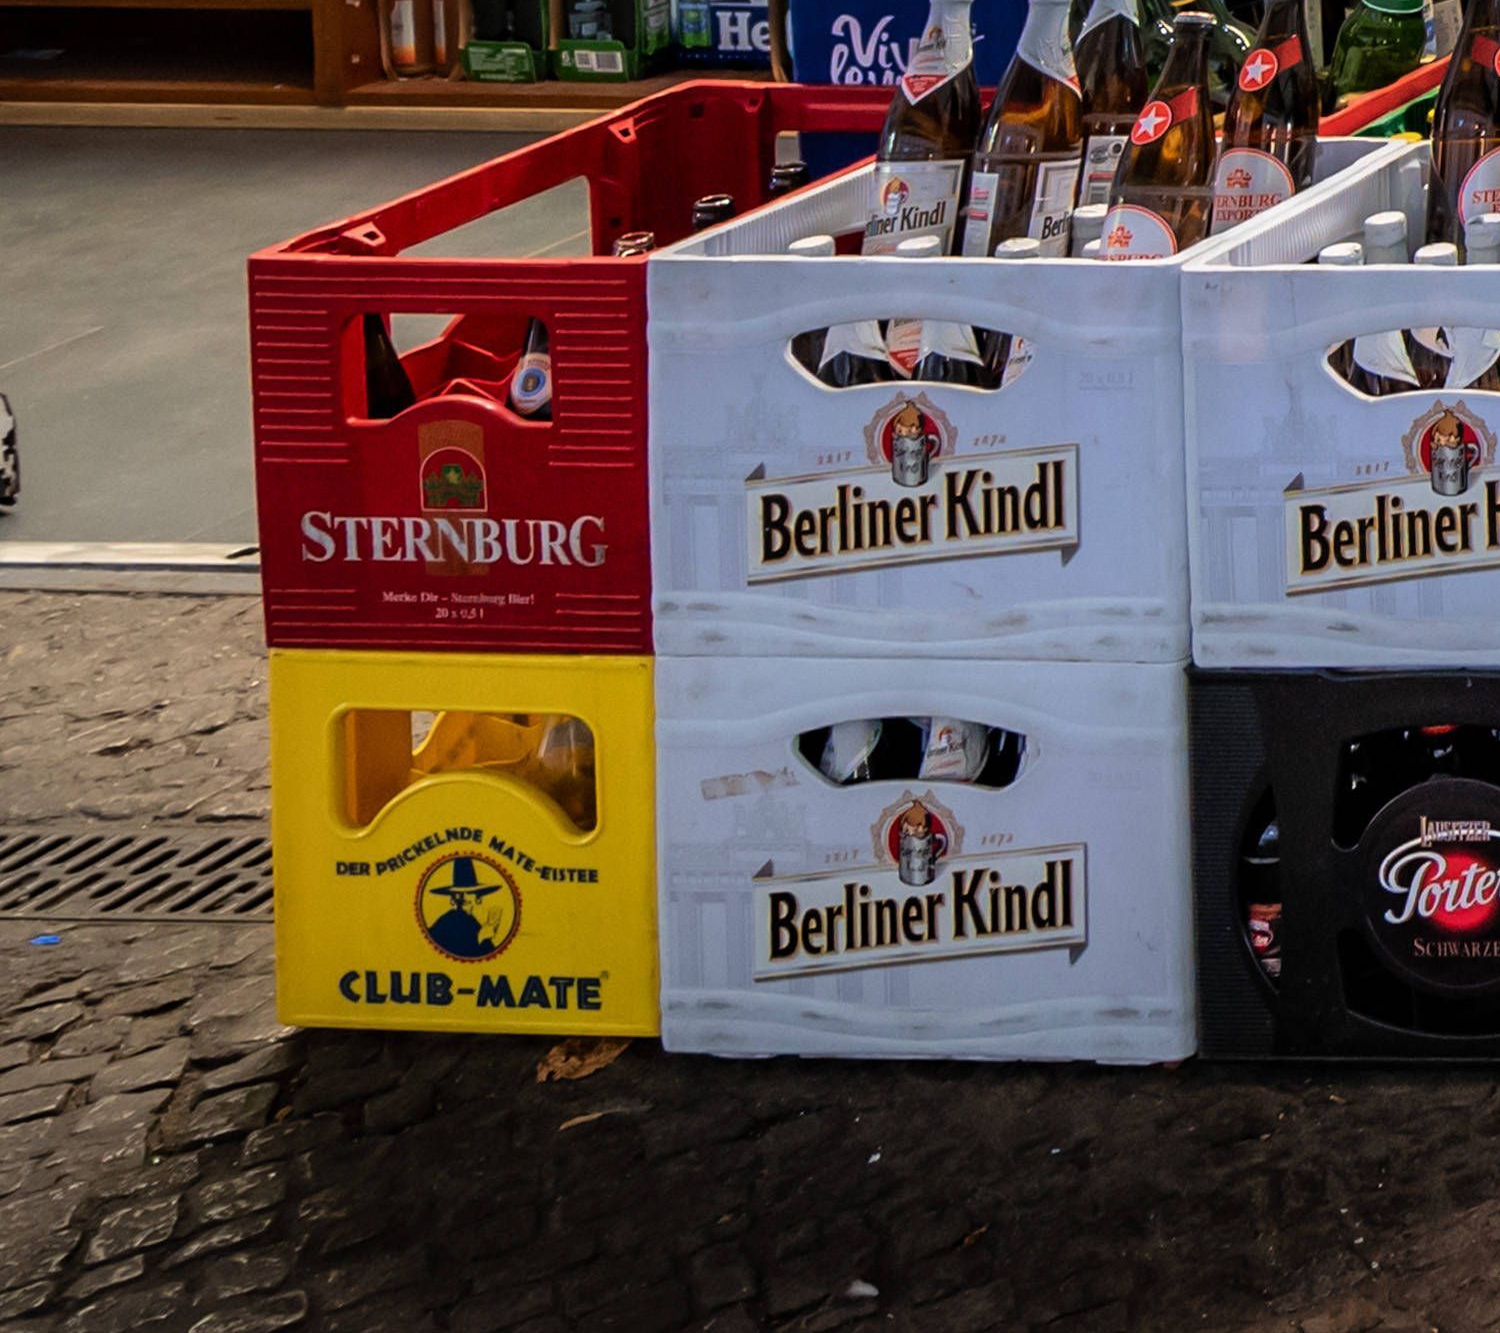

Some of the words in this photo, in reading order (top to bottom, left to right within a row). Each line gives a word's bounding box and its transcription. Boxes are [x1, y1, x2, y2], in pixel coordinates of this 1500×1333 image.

[900, 201, 946, 233] Kindl
[760, 481, 938, 565] Berliner
[946, 456, 1065, 541] Kindl
[1299, 490, 1479, 574] Berliner
[301, 511, 609, 570] STERNBURG
[380, 589, 416, 605] Merke
[418, 589, 440, 605] Dir
[450, 589, 504, 607] Sternburg
[506, 590, 535, 606] Bier!
[434, 606, 451, 620] 20
[336, 859, 372, 878] DER
[373, 827, 485, 877] PRICKELNDE
[488, 833, 601, 885] MATE-EISTEE
[767, 879, 944, 962] Berliner
[952, 859, 1074, 938] Kindl
[338, 970, 603, 1011] CLUB-MATE
